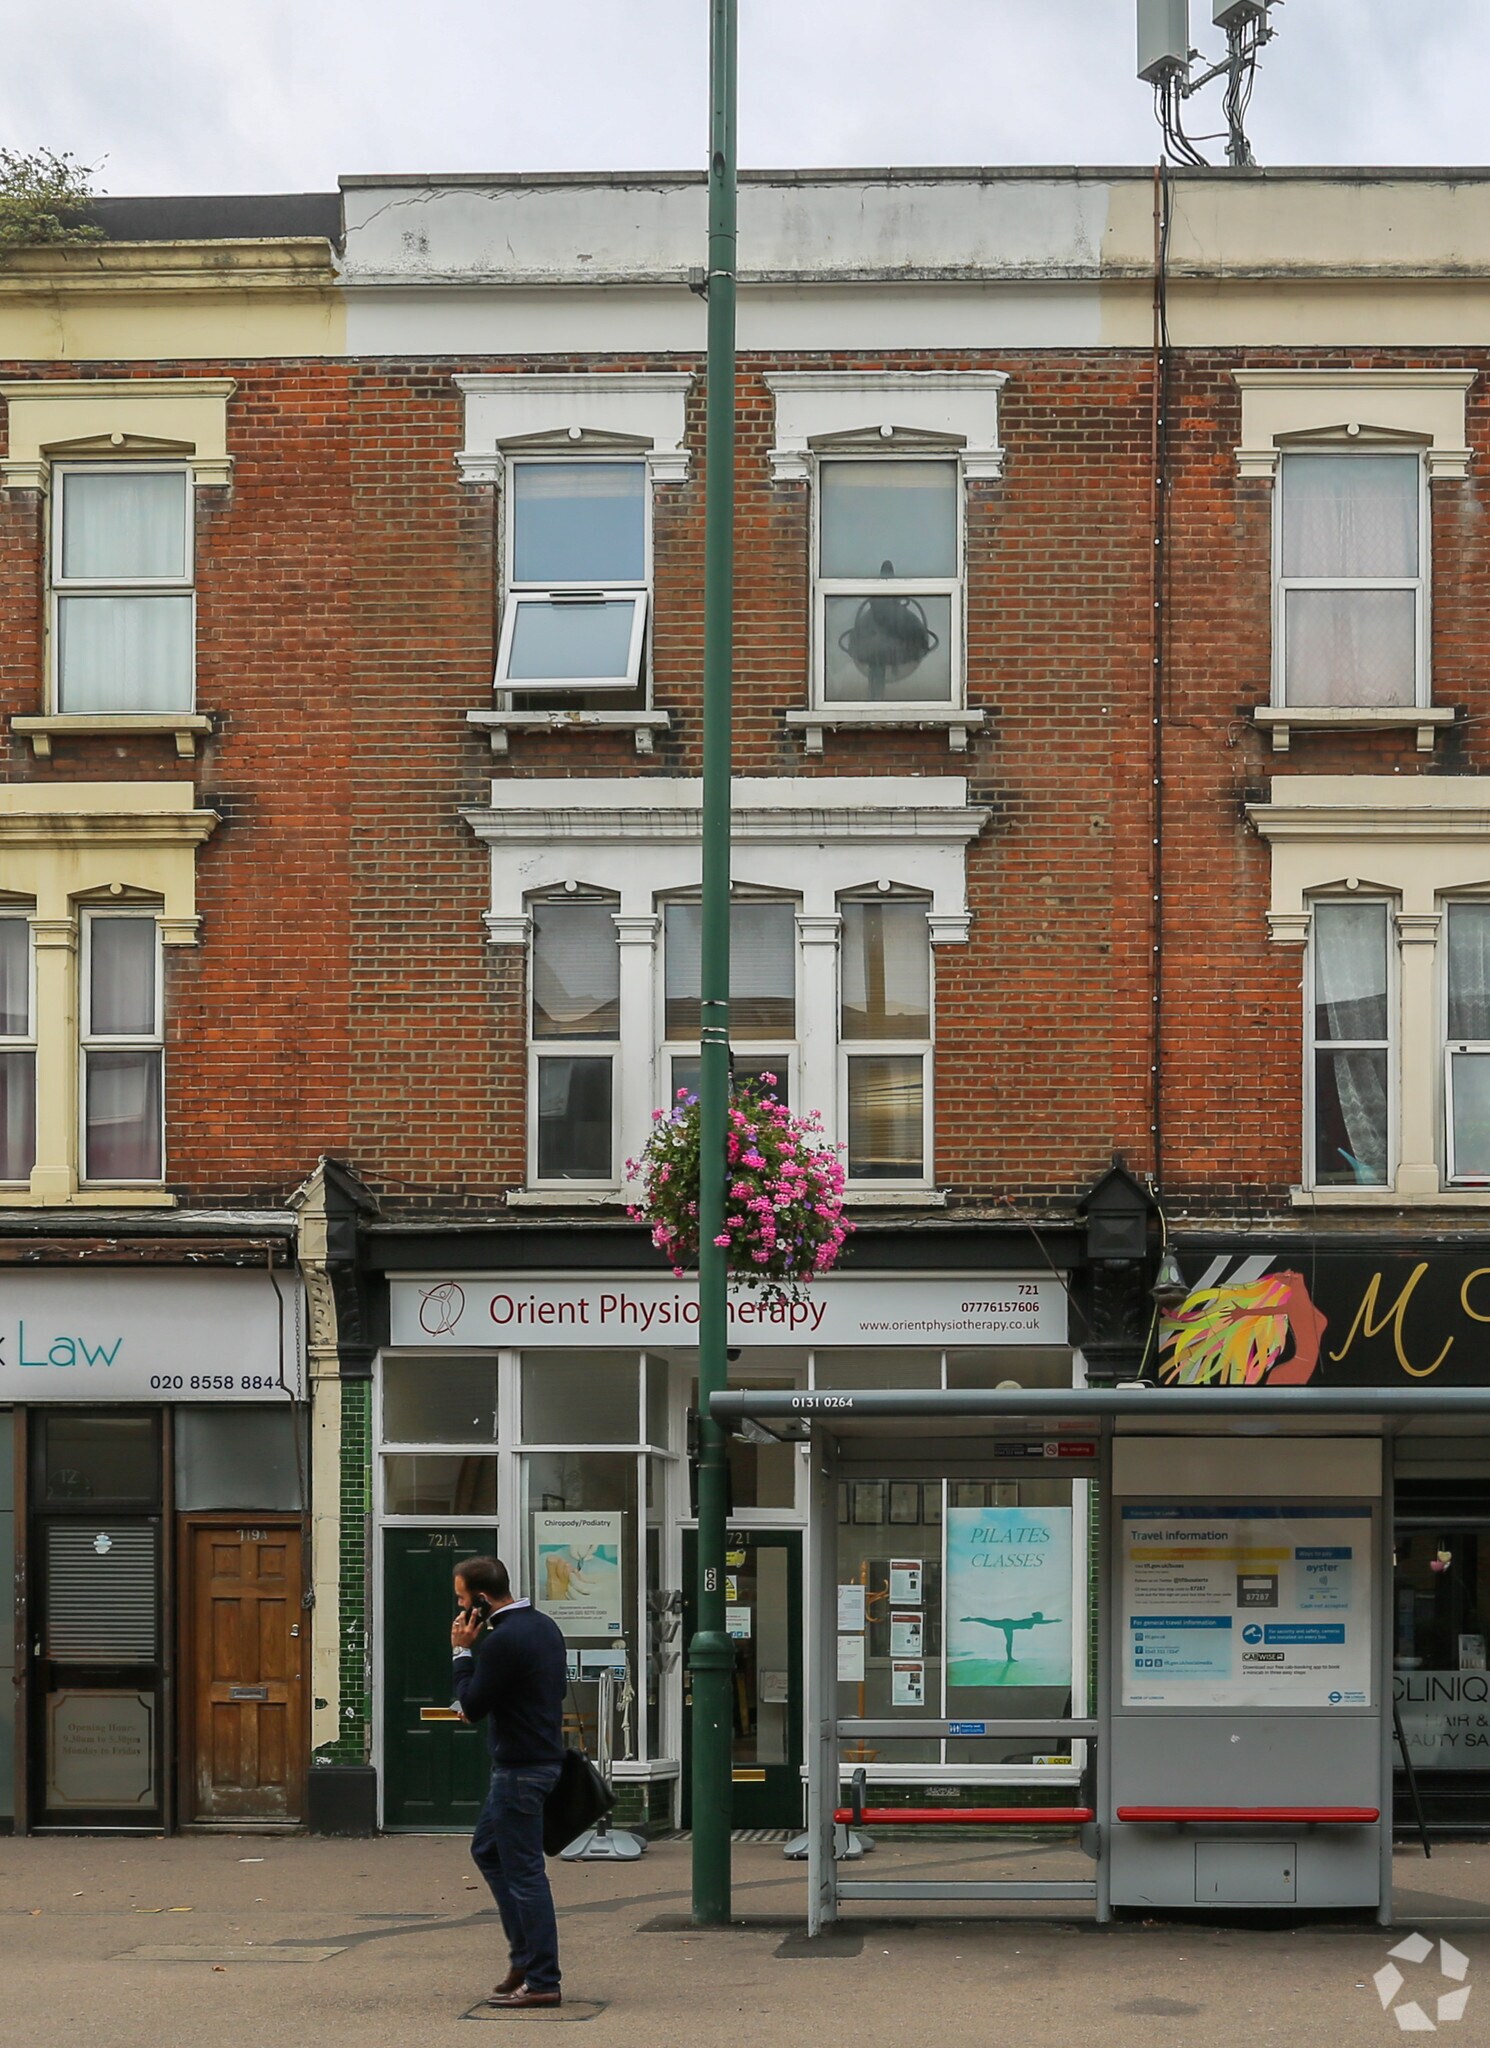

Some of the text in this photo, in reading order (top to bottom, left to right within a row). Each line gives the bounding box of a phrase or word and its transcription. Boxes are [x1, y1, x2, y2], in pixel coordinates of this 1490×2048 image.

[1018, 1285, 1039, 1296] 721
[489, 1294, 827, 1332] Orient Physioerapy
[961, 1302, 1040, 1313] 07776157606
[859, 1318, 1040, 1334] www.orientphysiotherapy.co.uk
[19, 1320, 122, 1366] Law
[150, 1375, 282, 1390] 020 8558 8844
[791, 1397, 854, 1408] 0131 0264
[544, 1519, 611, 1528] Chiropody/Podiatry
[236, 1529, 268, 1542] 719A
[428, 1533, 459, 1547] 721A
[728, 1532, 751, 1545] 721
[970, 1527, 1051, 1544] PILATES
[1131, 1530, 1229, 1541] Travel information
[971, 1553, 1046, 1568] CLASSES
[1306, 1562, 1339, 1574] oyster
[1143, 1619, 1164, 1627] general
[1243, 1653, 1276, 1661] CABWISE
[1476, 1713, 1489, 1727] &
